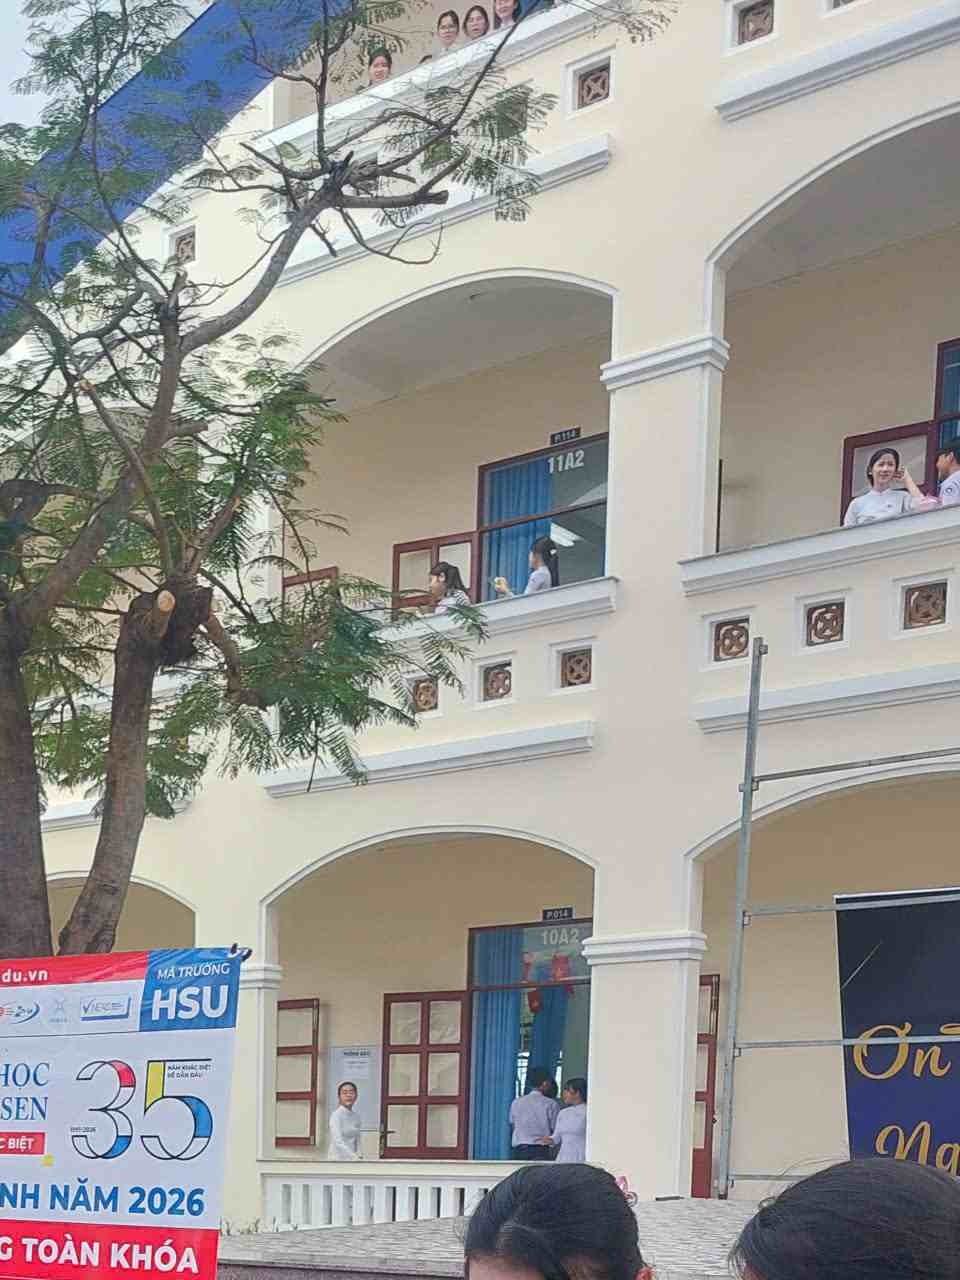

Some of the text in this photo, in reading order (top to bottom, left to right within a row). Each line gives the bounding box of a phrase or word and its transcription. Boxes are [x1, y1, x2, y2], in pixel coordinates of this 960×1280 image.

[547, 450, 584, 473] 11A2
[542, 928, 579, 945] 10A2
[157, 960, 230, 980] MÃ TRƯỜNG
[151, 985, 228, 1021] HSU
[0, 1095, 49, 1121] SEN
[71, 1058, 214, 1161] 35
[9, 1135, 35, 1154] BIỆT
[49, 1177, 120, 1213] NĂM
[128, 1187, 205, 1217] 2026
[21, 1232, 100, 1267] TOÀN
[109, 1238, 199, 1274] KHÓA
